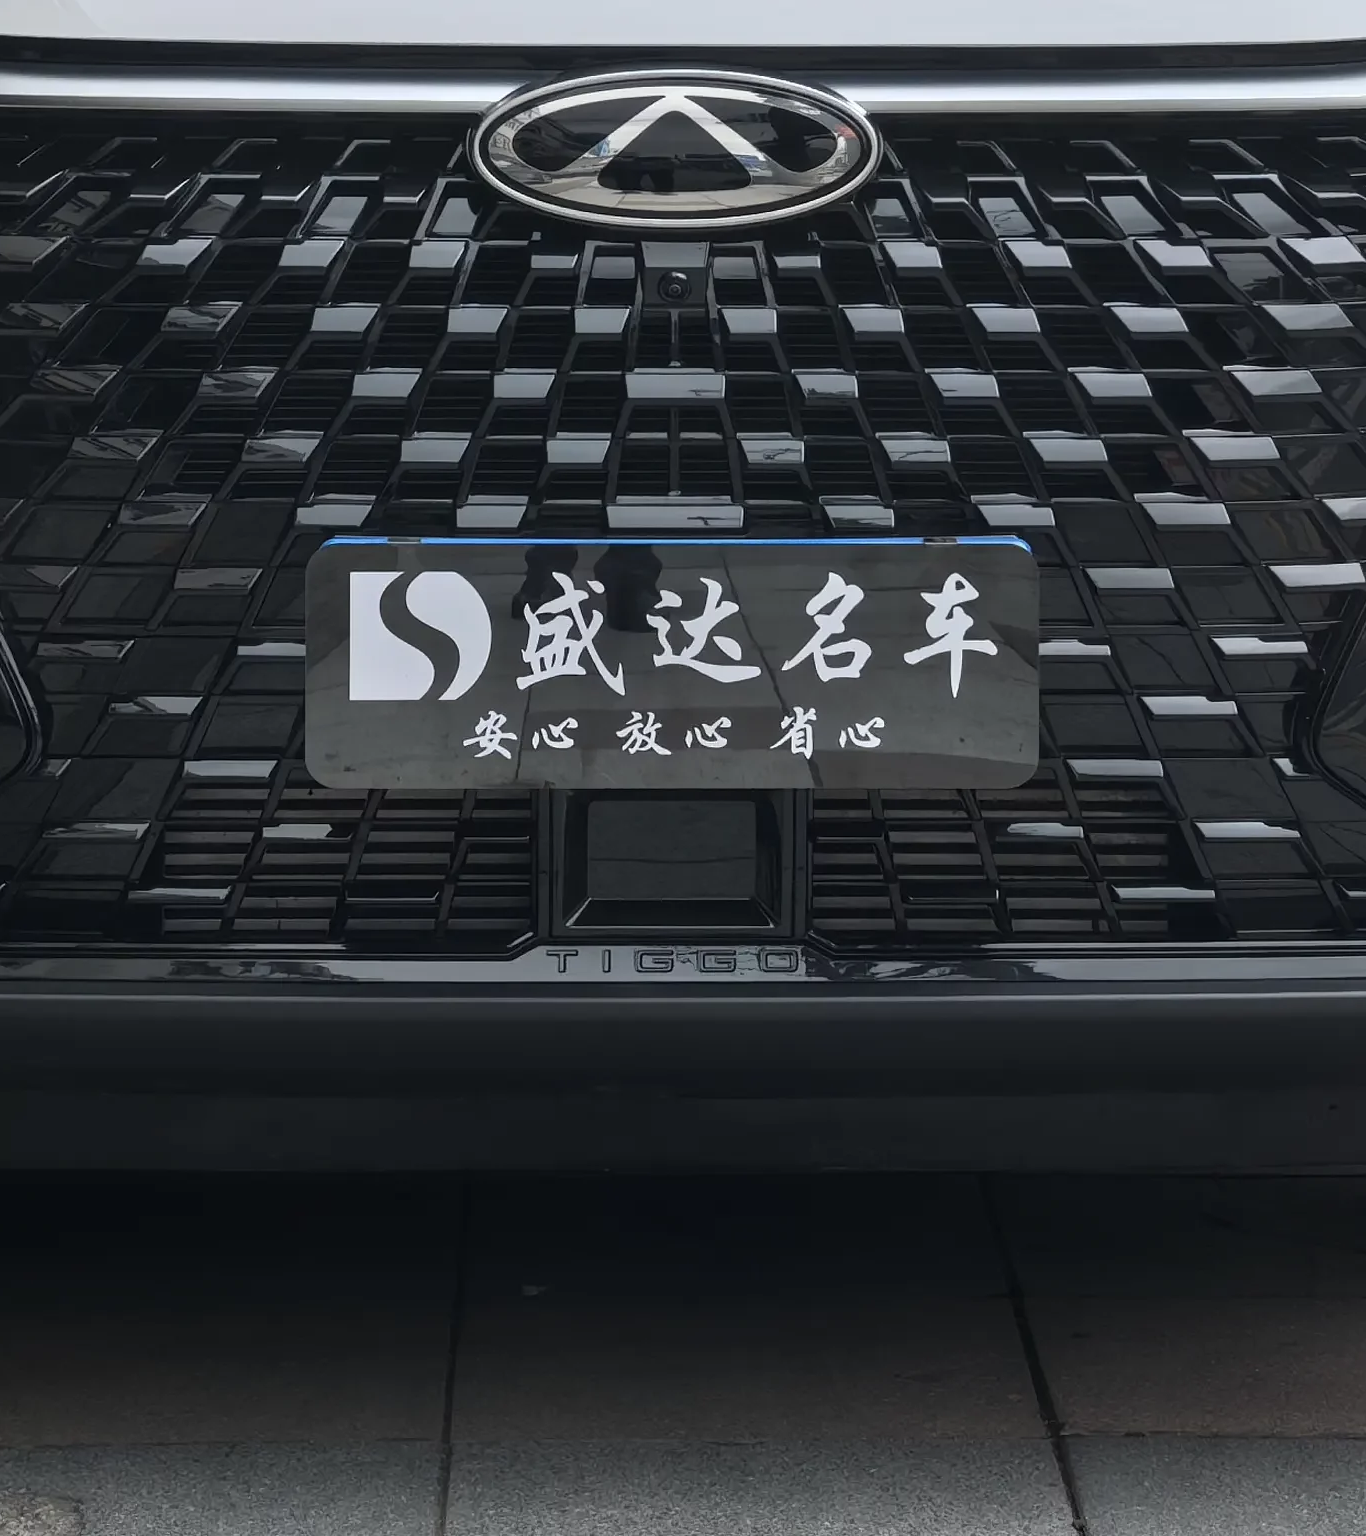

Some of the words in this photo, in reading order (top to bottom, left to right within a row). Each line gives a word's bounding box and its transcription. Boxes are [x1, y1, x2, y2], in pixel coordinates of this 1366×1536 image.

[515, 571, 999, 699] 盛达名车
[462, 710, 580, 760] 安心
[615, 710, 733, 756] 放心
[769, 706, 887, 760] 省心
[546, 949, 800, 974] TIGGO
